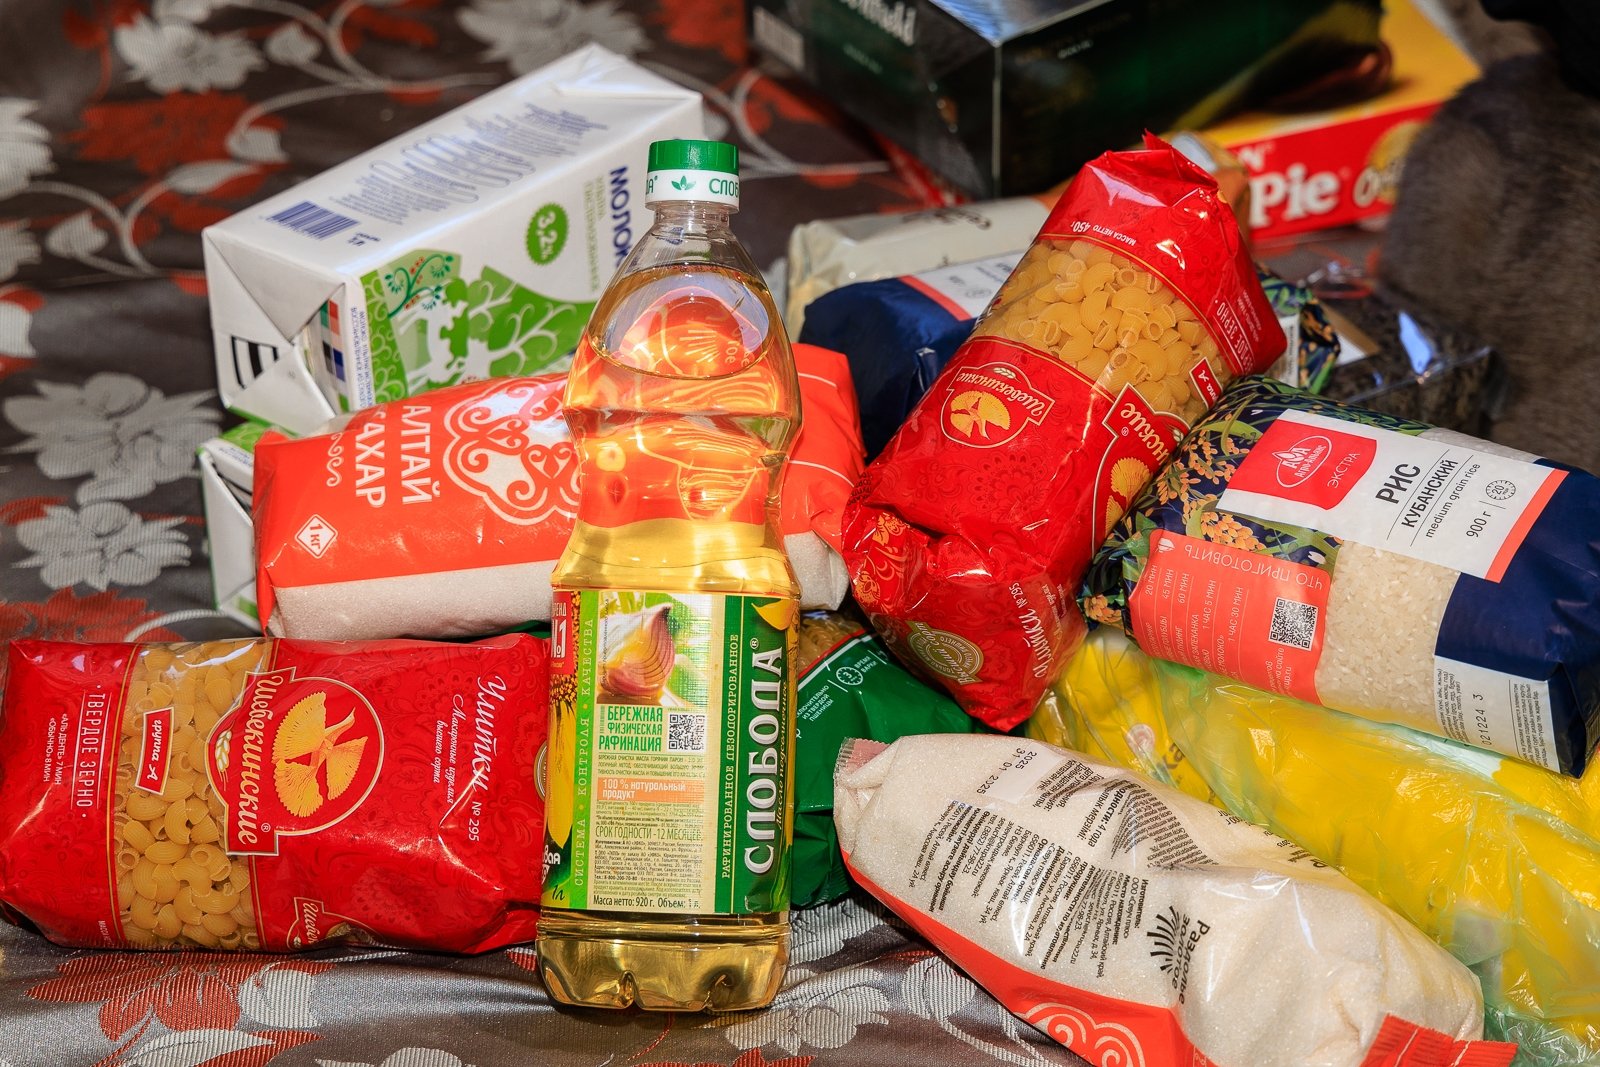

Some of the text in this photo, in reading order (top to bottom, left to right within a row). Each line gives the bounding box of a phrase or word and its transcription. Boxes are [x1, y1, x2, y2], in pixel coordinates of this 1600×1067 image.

[1250, 162, 1341, 228] Pie
[1072, 221, 1136, 246] МАССА НЕТТО 450
[1216, 302, 1238, 340] ЗЕРНО
[956, 372, 1045, 417] Шебекинские
[400, 405, 440, 505] АЛТАЙ
[1327, 453, 1361, 489] ЭКСТРА
[1375, 463, 1421, 504] РИС
[1401, 459, 1459, 528] КУБАНСКИЙ
[1425, 463, 1481, 539] medium grain rice
[1491, 484, 1505, 495] 20
[1466, 517, 1488, 538] 900
[1145, 564, 1158, 596] 20 МИН
[1184, 544, 1323, 590] ЧТО ПРИГОТОВИТЬ
[1008, 582, 1024, 599] 295
[1162, 568, 1174, 600] 45 МИН
[1177, 573, 1190, 604] 60 МИН
[1206, 580, 1217, 599] МИН
[1202, 606, 1212, 626] ЧАС
[1228, 587, 1243, 637] ЧАС 30 МИН
[1190, 614, 1200, 656] ЗАПЕКАНКА
[581, 619, 593, 696] КАЧЕСТВА
[853, 655, 871, 669] ВРЕМЯ
[860, 660, 878, 673] ВАРКИ
[727, 633, 739, 762] ДЕЗОДОРИРОВАННОЕ
[808, 693, 830, 713] ТВЕРДОЙ
[808, 698, 834, 722] ПШЕНИЦЫ
[607, 705, 663, 722] БЕРЕЖНАЯ
[1472, 693, 1492, 745] 021224 3
[471, 675, 507, 793] Улитки
[607, 722, 663, 735] ФИЗИЧЕСКАЯ
[76, 693, 106, 807] ТВЕРДОЕ ЗЕРНО
[146, 719, 163, 781] группа А
[578, 717, 590, 796] КОНТРОЛЯ
[598, 735, 662, 752] РАФИНАЦИЯ
[43, 763, 52, 782] МИН
[237, 675, 284, 846] Шебекинские
[976, 747, 1026, 794] 31 01 2025
[1015, 751, 1037, 770] 2025
[54, 767, 64, 785] МИН
[602, 779, 618, 789] 100
[602, 789, 636, 800] продукт
[468, 818, 480, 842] 295
[595, 826, 613, 838] СРОК
[614, 826, 652, 840] ГОДНОСТИ
[721, 765, 735, 879] РАФИНИРОВАННОЕ
[1098, 824, 1107, 832] 4
[977, 825, 992, 846] (3852)
[1087, 830, 1102, 848] года
[574, 818, 587, 887] СИСТЕМА
[928, 840, 941, 860] Алтай
[948, 843, 970, 880] дайындау
[937, 860, 952, 883] асыру
[1012, 858, 1028, 879] Ресей,
[938, 879, 954, 911] бойынша
[1002, 879, 1016, 900] Алтай
[1051, 880, 1069, 903] Россия,
[1068, 864, 1096, 913] деятельности
[1119, 874, 1131, 898] Место
[1130, 876, 1140, 895] ООО
[593, 894, 613, 906] Масса
[614, 896, 635, 907] нетто:
[635, 896, 649, 907] 920
[657, 897, 686, 908] Объем:
[984, 904, 993, 915] 34
[1030, 894, 1049, 924] Аносова,
[1107, 900, 1117, 926] Россия,
[1033, 904, 1054, 940] Алтайский
[1062, 911, 1070, 922] по
[1094, 918, 1105, 944] Ярных,
[1101, 926, 1112, 961] Алтайский
[1024, 939, 1037, 957] край,
[1172, 914, 1190, 989] золотое
[1178, 919, 1211, 1005] Раздолье
